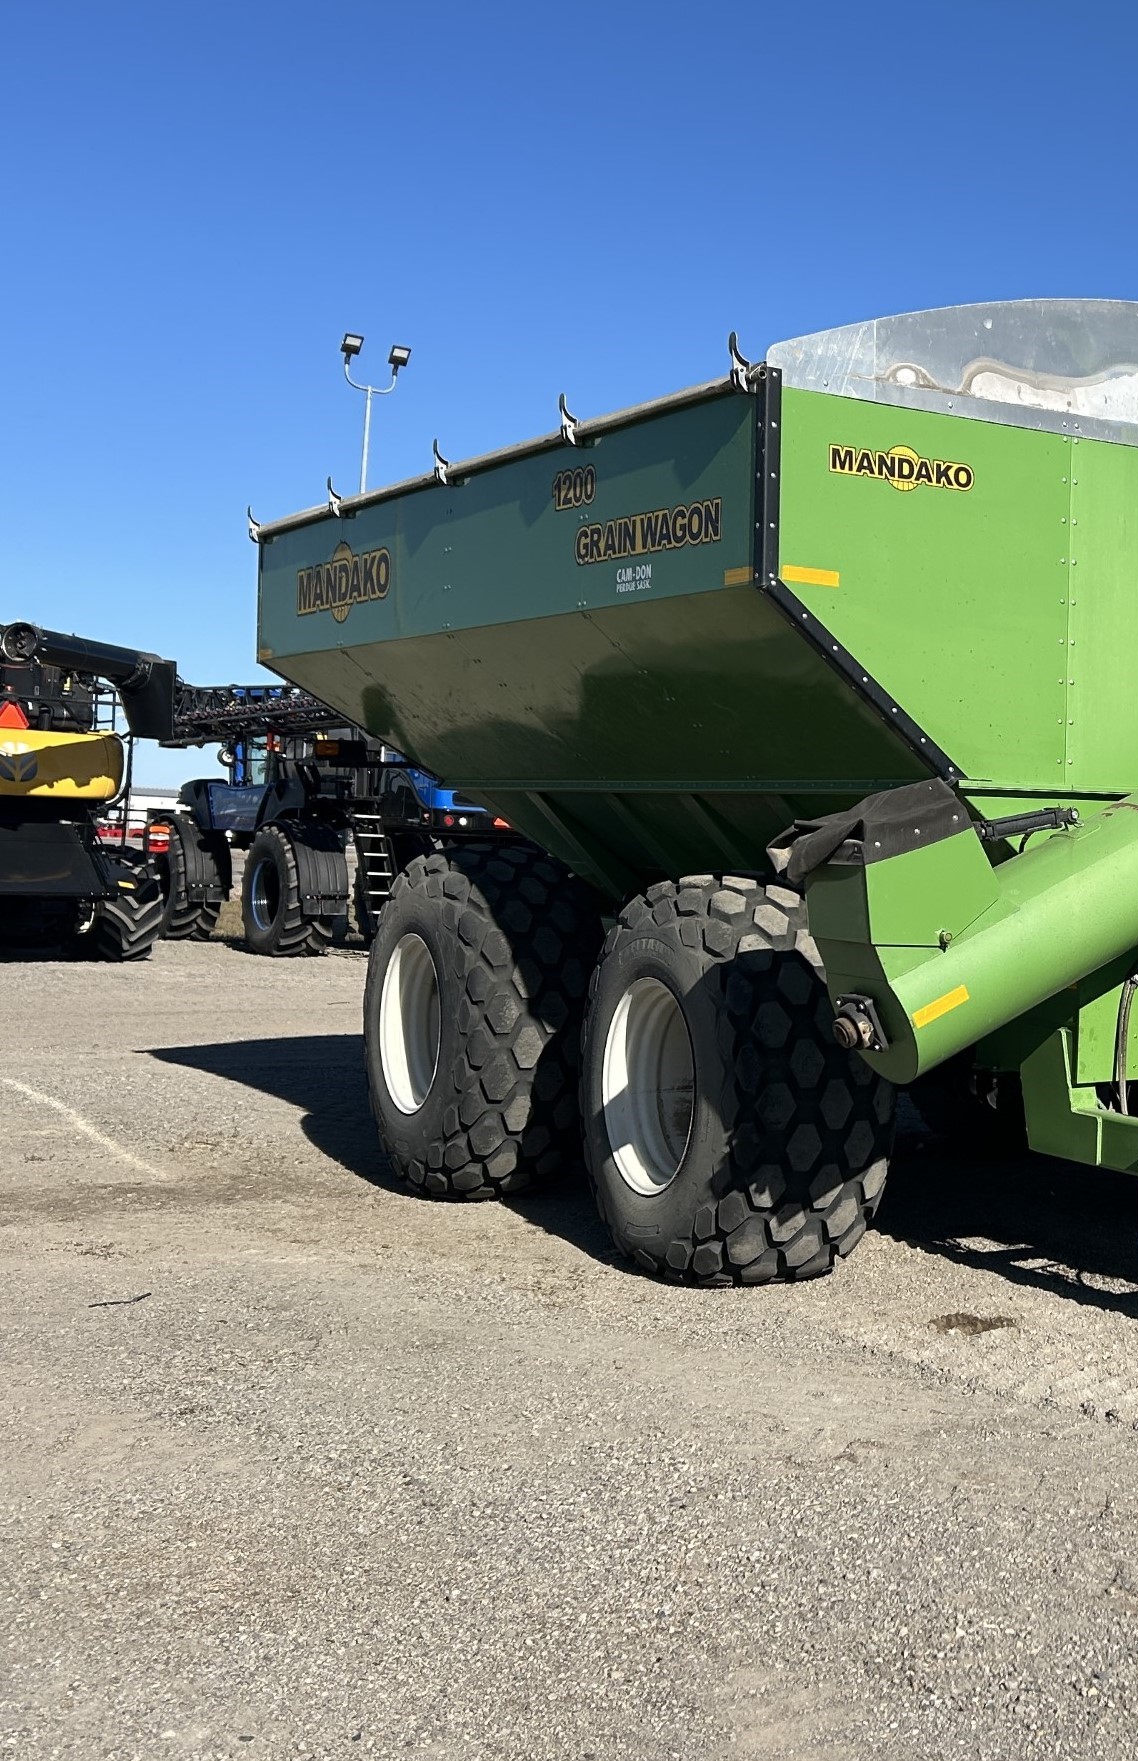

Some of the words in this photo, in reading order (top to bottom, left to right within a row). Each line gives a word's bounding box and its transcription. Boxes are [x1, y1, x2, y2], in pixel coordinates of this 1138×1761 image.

[553, 465, 595, 511] 1200
[830, 445, 973, 490] MANDAKO
[575, 514, 638, 565] GRAIN
[639, 498, 721, 552] WAGON
[297, 548, 390, 615] MANDAKO
[616, 564, 652, 583] CAM-DON
[616, 581, 636, 593] PERDUE
